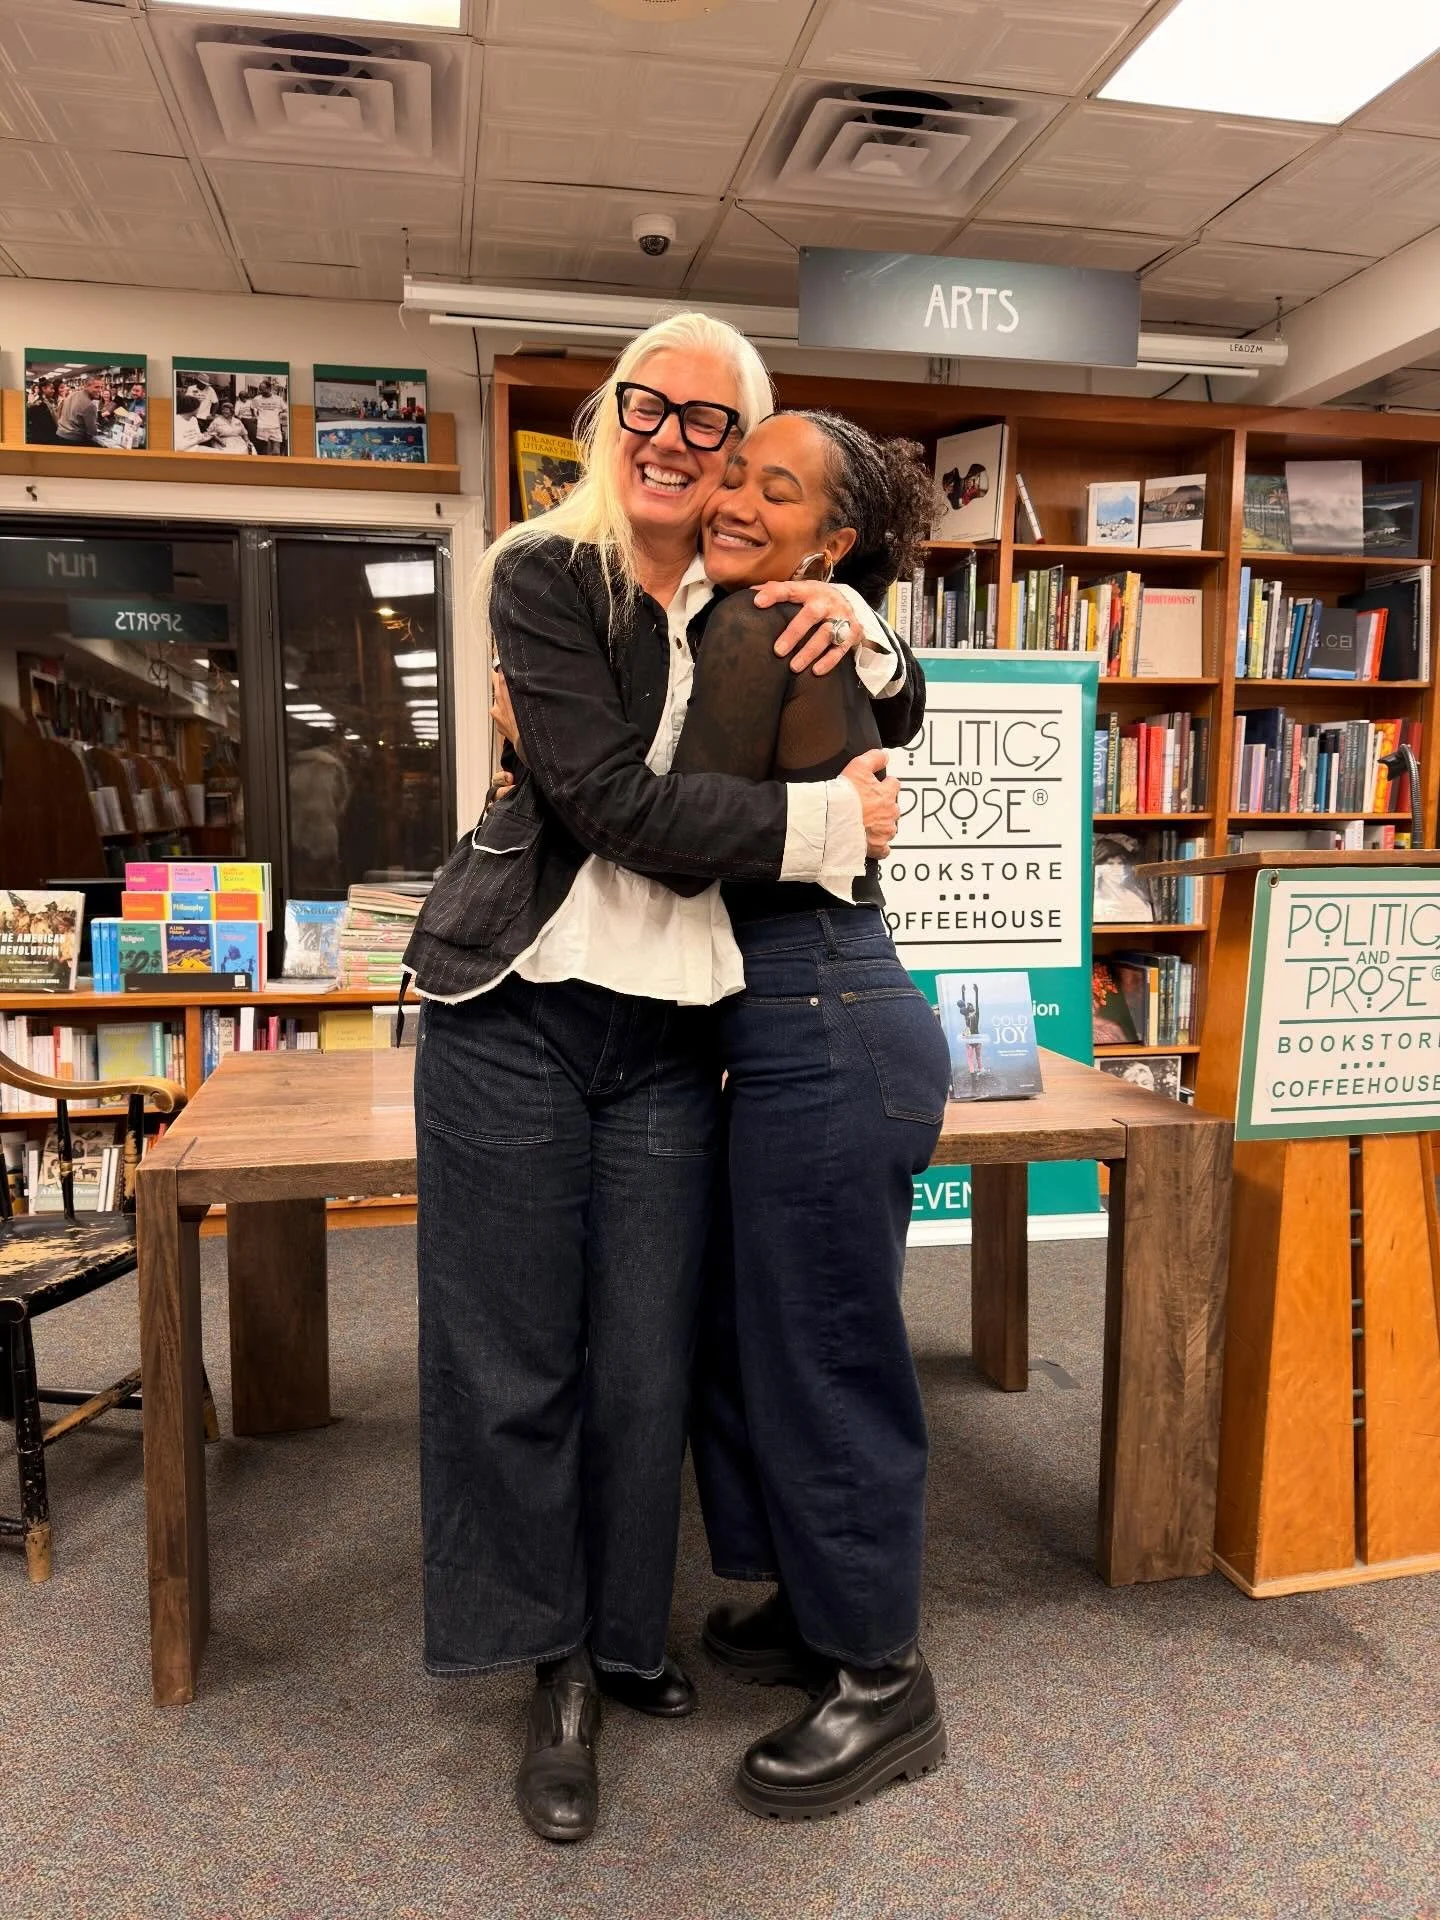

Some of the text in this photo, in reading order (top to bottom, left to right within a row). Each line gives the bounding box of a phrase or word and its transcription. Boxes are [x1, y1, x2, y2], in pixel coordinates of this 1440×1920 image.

[923, 284, 1020, 333] ARTS
[1107, 716, 1118, 785] KENT MONKMAN
[945, 771, 983, 787] AND
[172, 903, 204, 912] Philosophy
[885, 909, 1062, 931] OFFEEHOUSE
[1288, 902, 1440, 950] POLITIC
[17, 933, 65, 943] AMERICAN
[121, 935, 145, 943] Religion
[0, 945, 60, 956] REVOLUTION
[1356, 950, 1390, 965] AND
[991, 1015, 1028, 1027] COLD
[992, 1026, 1028, 1044] JOY
[1278, 1032, 1440, 1054] BOOKSTOR
